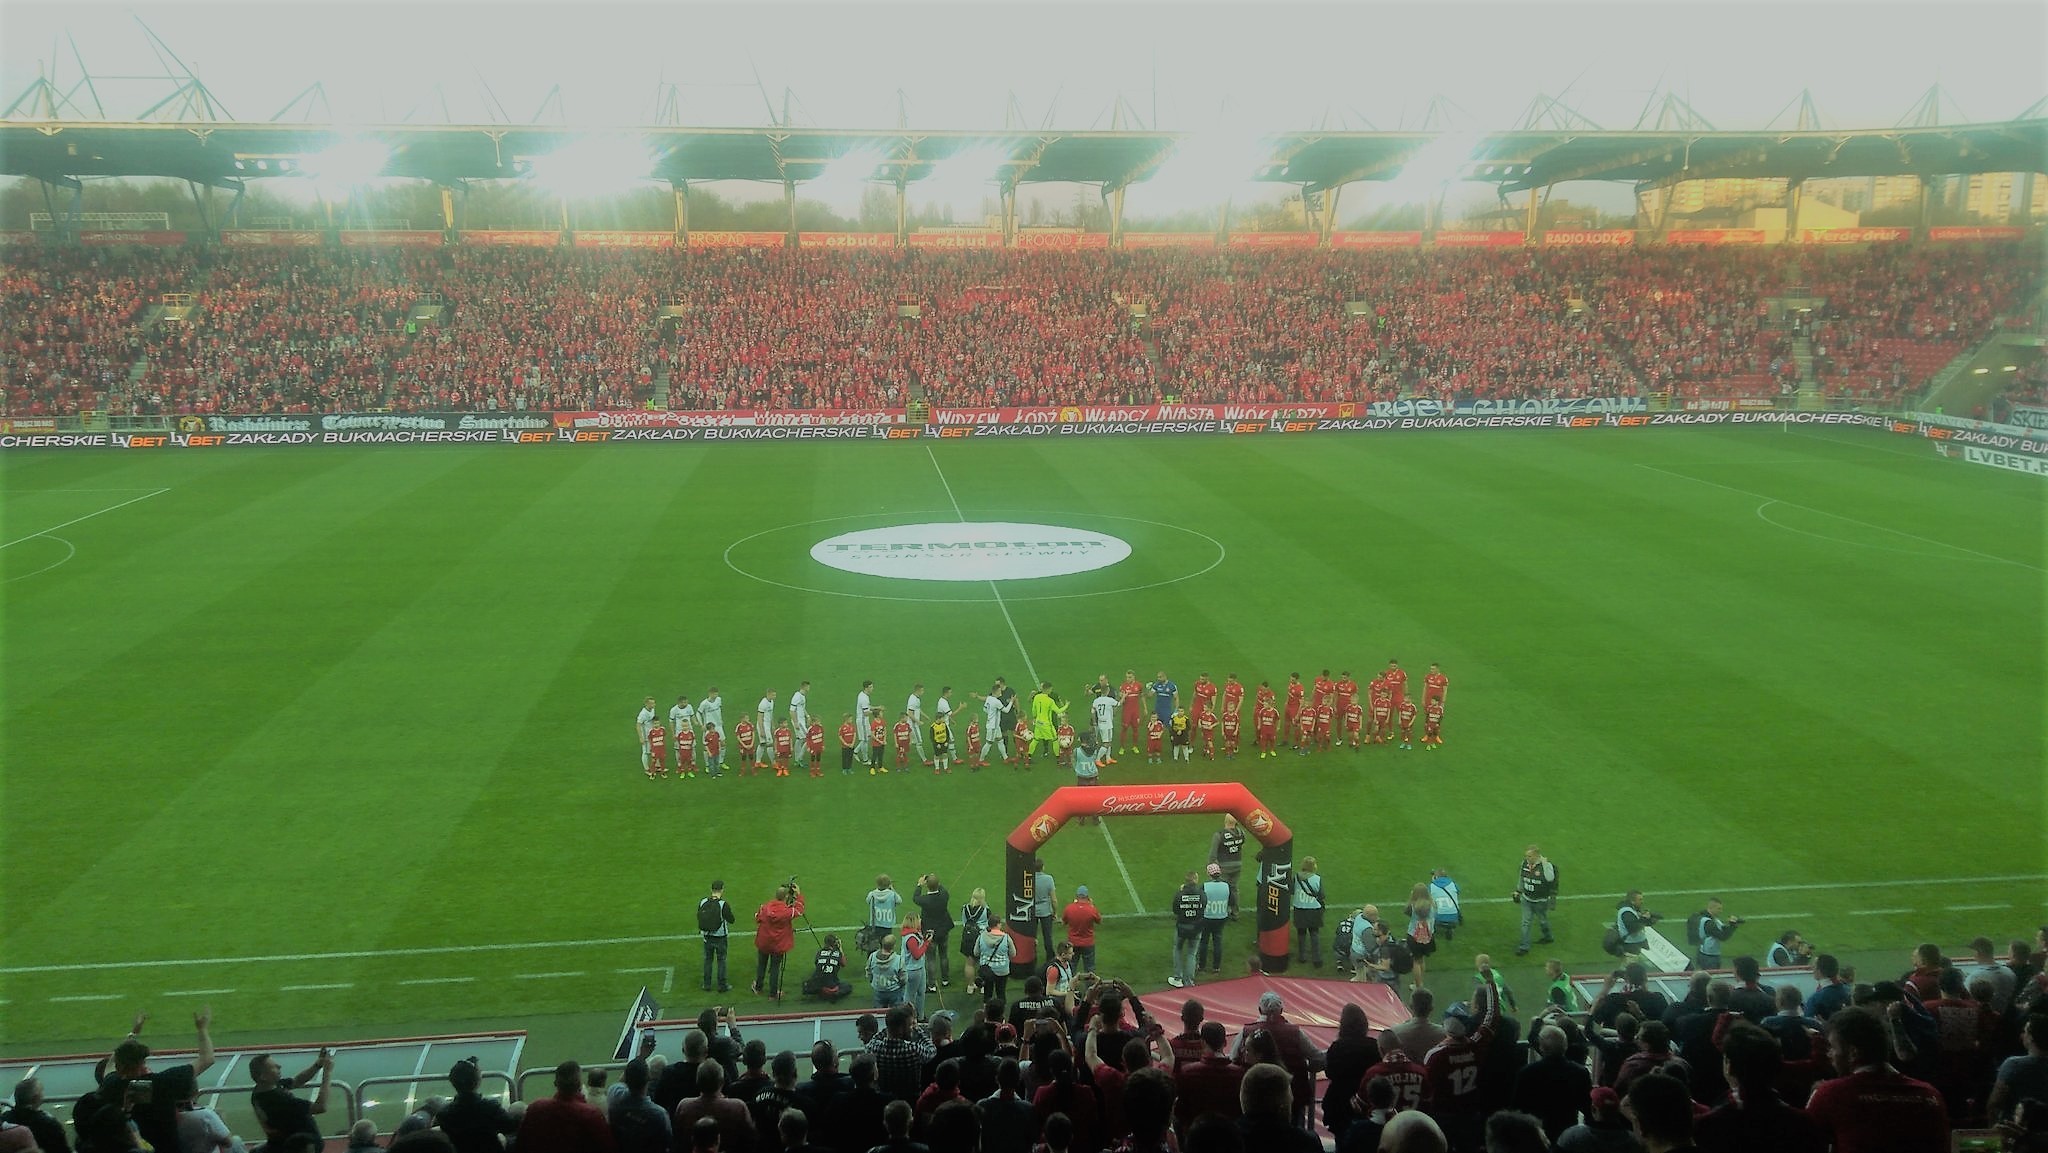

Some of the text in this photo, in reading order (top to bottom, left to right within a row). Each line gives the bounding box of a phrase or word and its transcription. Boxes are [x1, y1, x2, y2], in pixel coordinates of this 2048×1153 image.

[689, 233, 746, 246] PROCAD
[1018, 234, 1072, 247] PROCAD
[1546, 231, 1584, 244] RADIO
[1156, 406, 1215, 420] MIASTA
[226, 432, 319, 445] ZAKŁADY
[323, 430, 498, 443] BUKMACHERSKIE
[611, 428, 701, 440] ZAKŁADY
[704, 427, 868, 440] BUKMACHERSKIE
[974, 425, 1057, 436] ZAKŁADY
[1060, 422, 1216, 434] BUKMACHERSKIE
[1317, 418, 1399, 430] ZAKŁADY
[1401, 416, 1553, 429] BUKMACHERSKIE
[1651, 412, 1730, 425] ZAKŁADY
[1732, 412, 1882, 427] BUKMACHERSKIE
[1953, 429, 2019, 448] ZAKŁADY
[1102, 796, 1146, 814] Serce
[1448, 1066, 1478, 1096] 12
